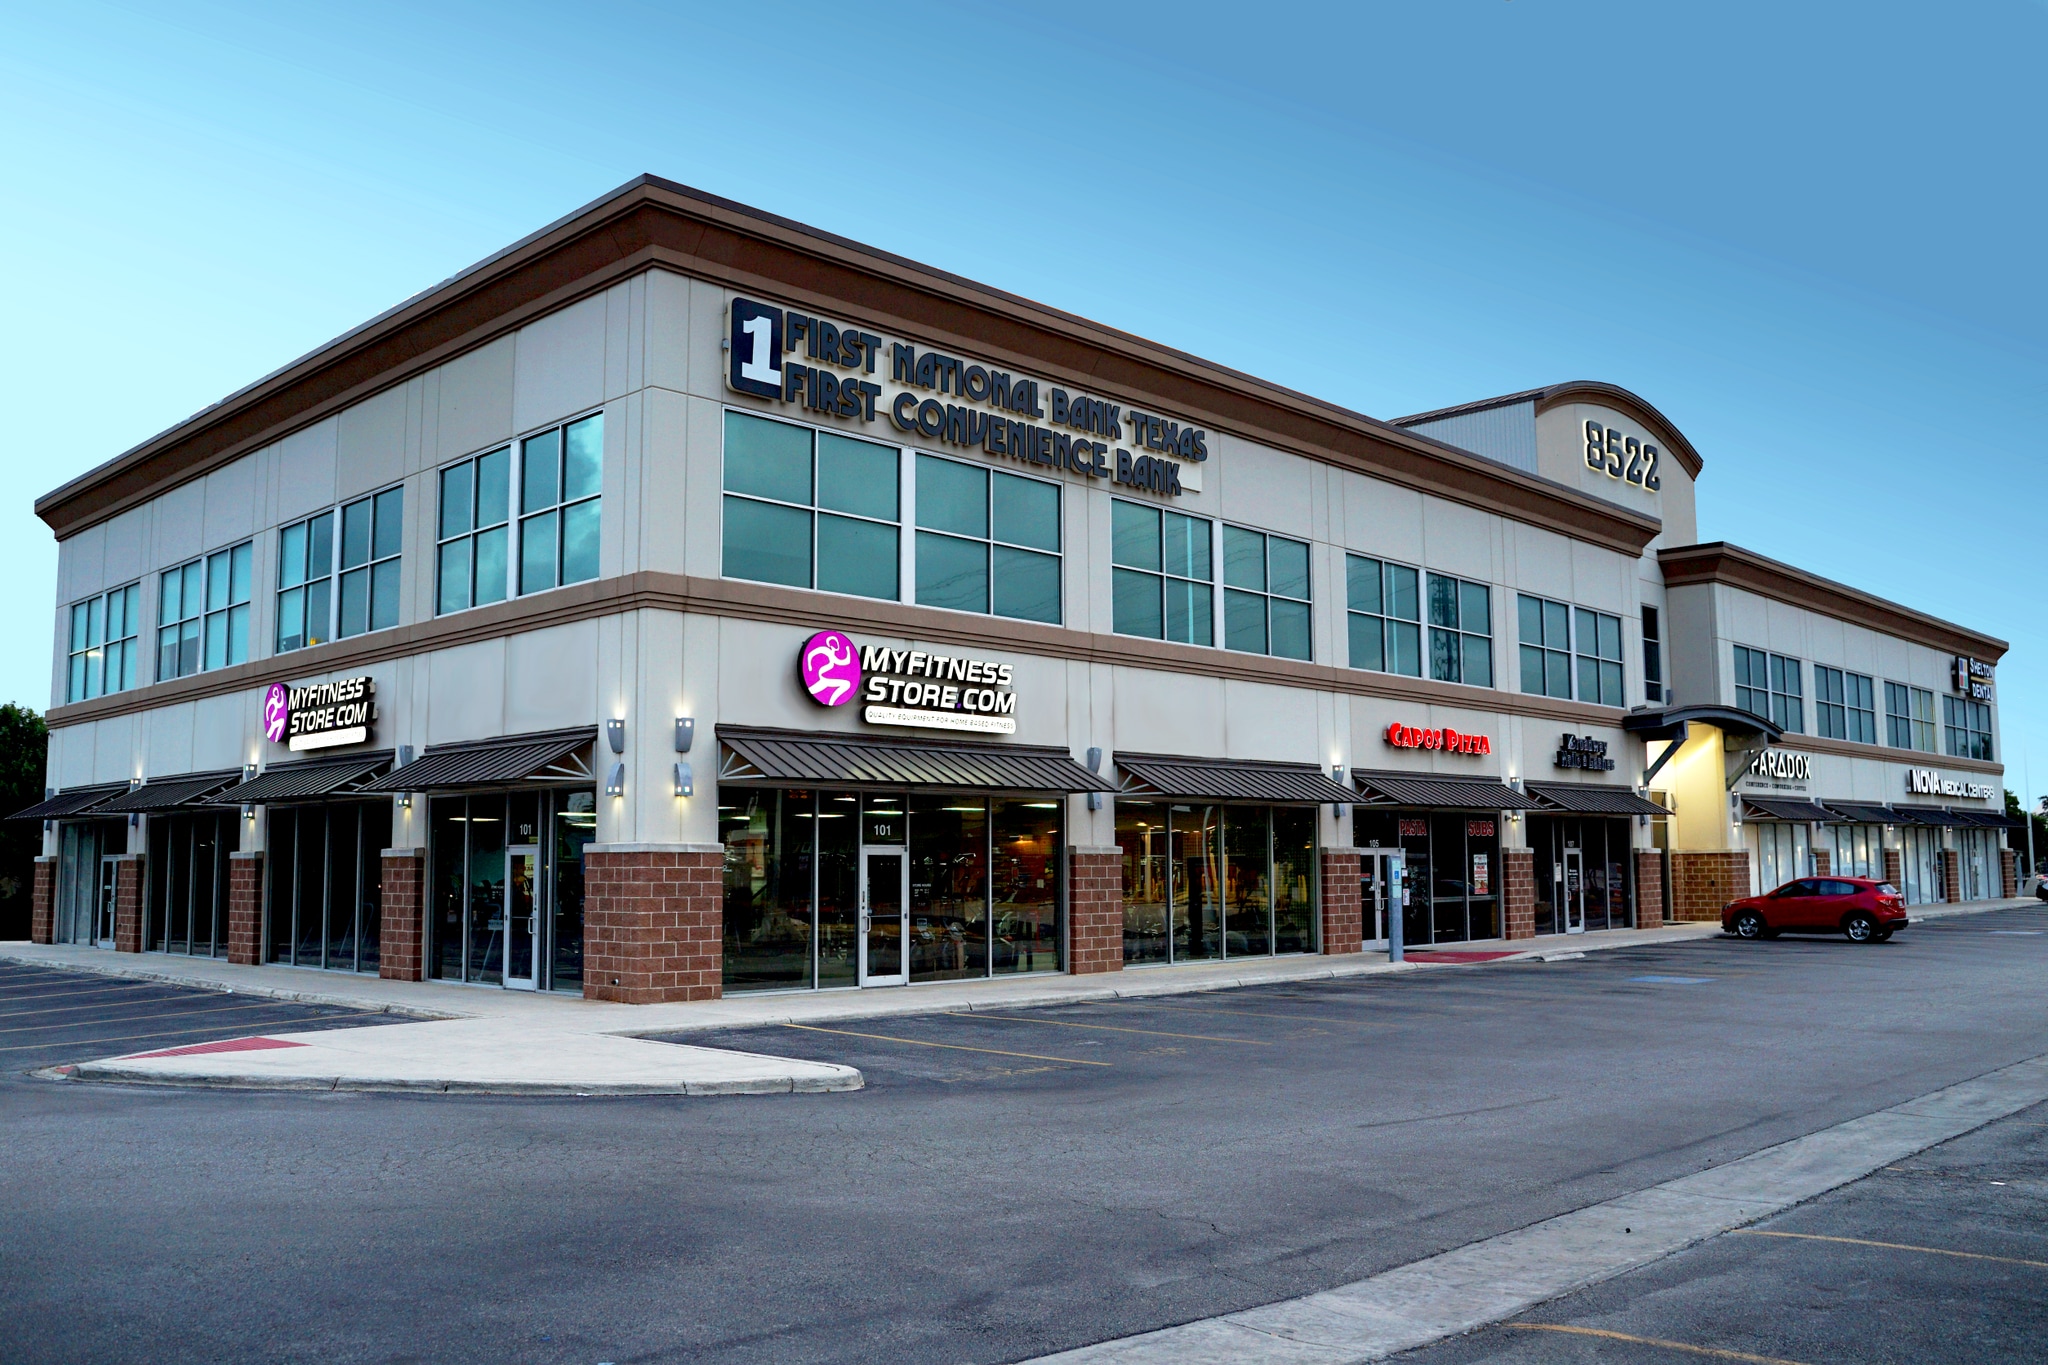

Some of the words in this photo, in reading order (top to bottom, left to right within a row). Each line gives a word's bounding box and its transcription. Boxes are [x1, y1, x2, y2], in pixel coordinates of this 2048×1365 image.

[741, 315, 782, 386] 1
[786, 311, 882, 374] FIRST
[891, 341, 1044, 418] NATIONAL
[1051, 387, 1122, 439] BANK
[1129, 410, 1208, 461] TEXAS
[784, 361, 882, 422] FIRST
[892, 392, 1108, 478] CONVENIENCE
[1115, 448, 1182, 496] BANK
[1585, 420, 1660, 491] 8522
[862, 646, 1014, 686] MYFITNESS
[1969, 656, 1994, 678] SHELTON
[288, 676, 366, 711] MYFITNESS
[866, 676, 1017, 714] STORE.COM
[1971, 682, 1994, 701] DENTAL
[290, 701, 368, 734] STORE.COM
[867, 710, 896, 720] QUALITY
[897, 713, 935, 723] EQUIPMENT
[969, 720, 989, 728] BASED
[990, 722, 1015, 730] FITNESS
[1445, 727, 1492, 755] PIZZA
[1751, 751, 1812, 779] PARADOX
[1911, 769, 1941, 794] NOVA
[1941, 779, 1968, 797] MEDICAL
[1968, 783, 1995, 799] CENTERS
[519, 823, 532, 836] 101
[874, 824, 892, 836] 101
[1400, 819, 1427, 836] PASTA
[1467, 820, 1494, 836] SUBS
[1369, 839, 1380, 848] 105
